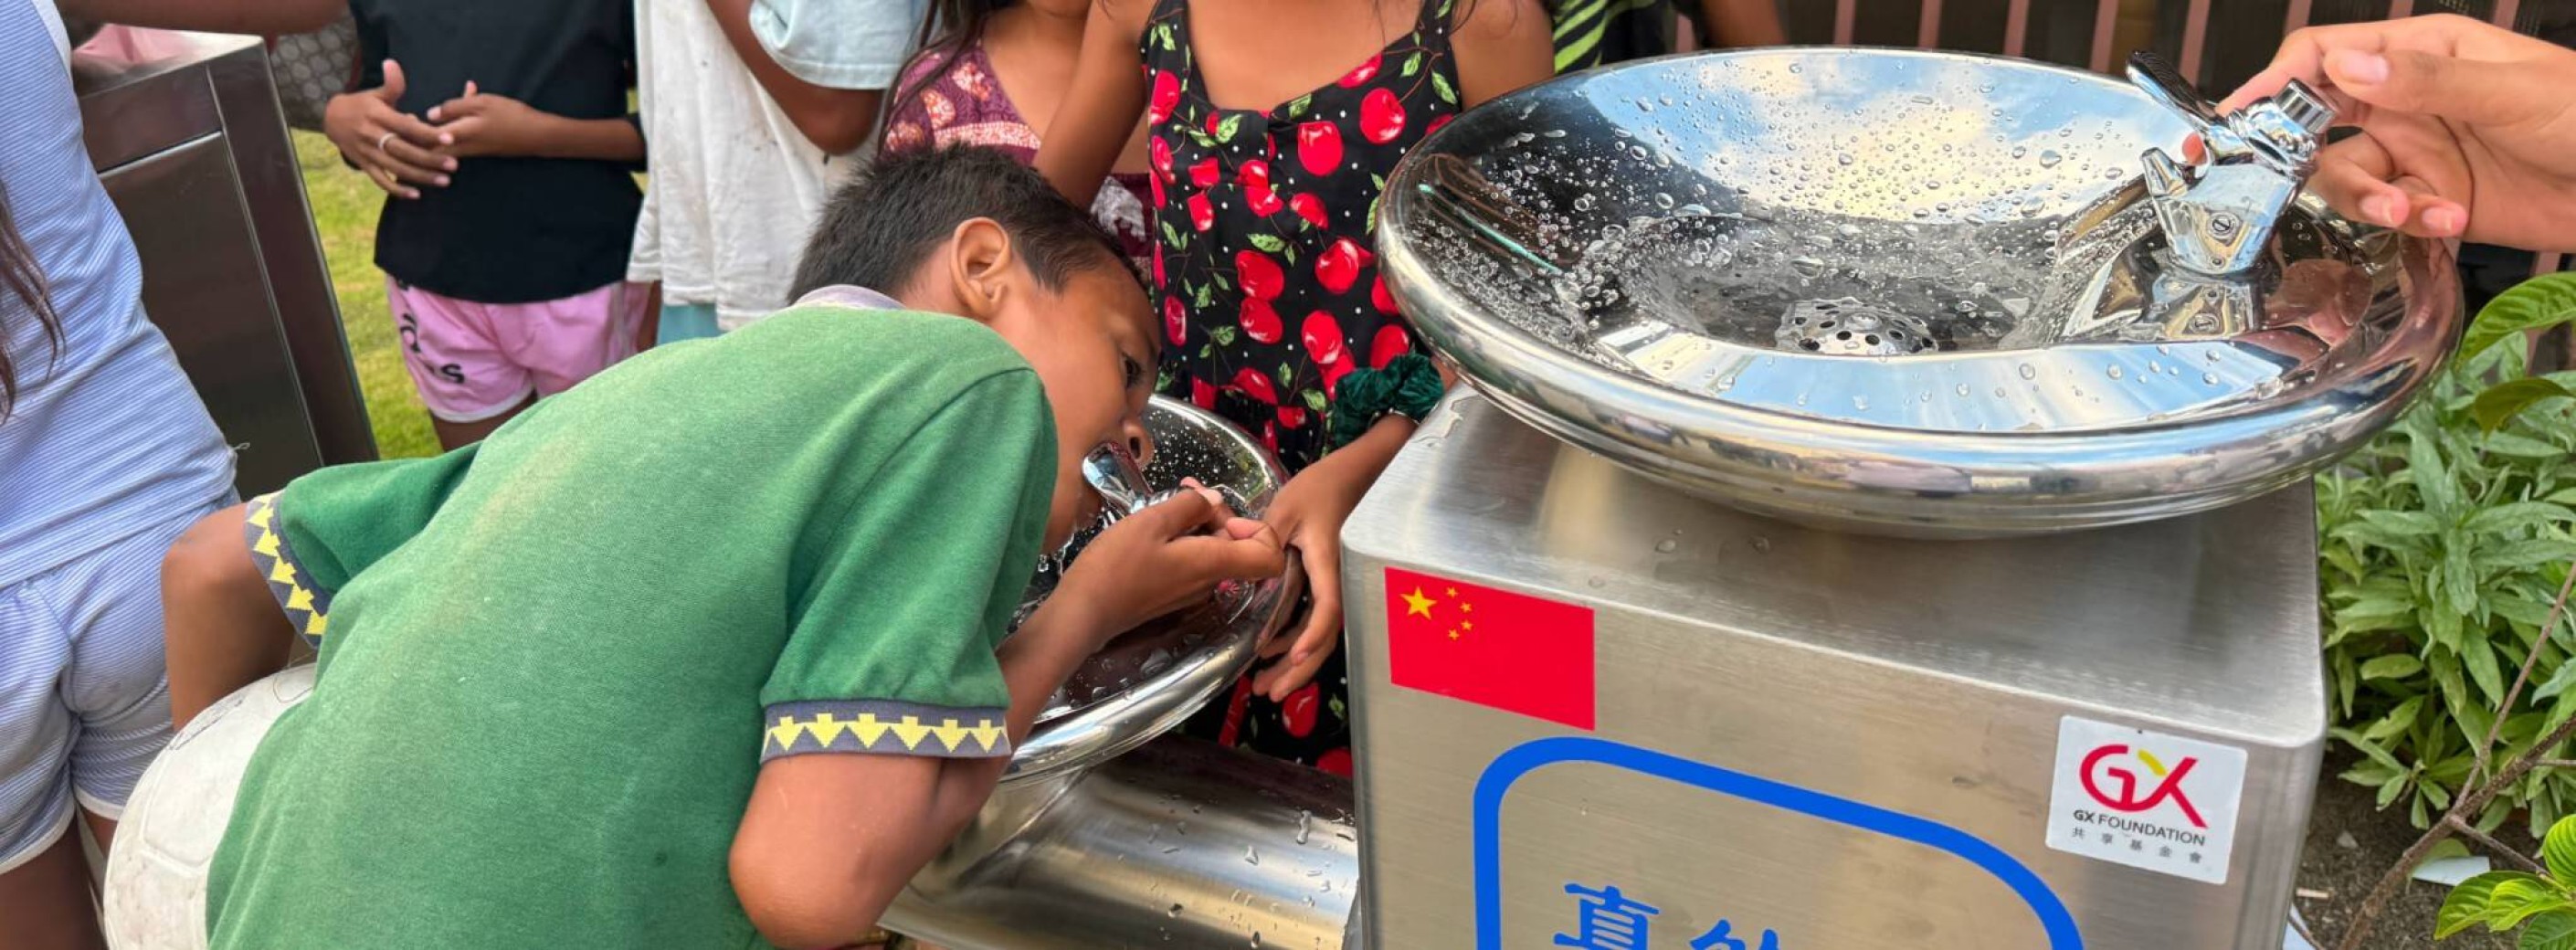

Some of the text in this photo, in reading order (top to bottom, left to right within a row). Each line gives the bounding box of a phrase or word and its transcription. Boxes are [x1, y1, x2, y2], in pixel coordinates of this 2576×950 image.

[2080, 744, 2208, 828] GX
[2074, 809, 2206, 846] GX FOUNDATION
